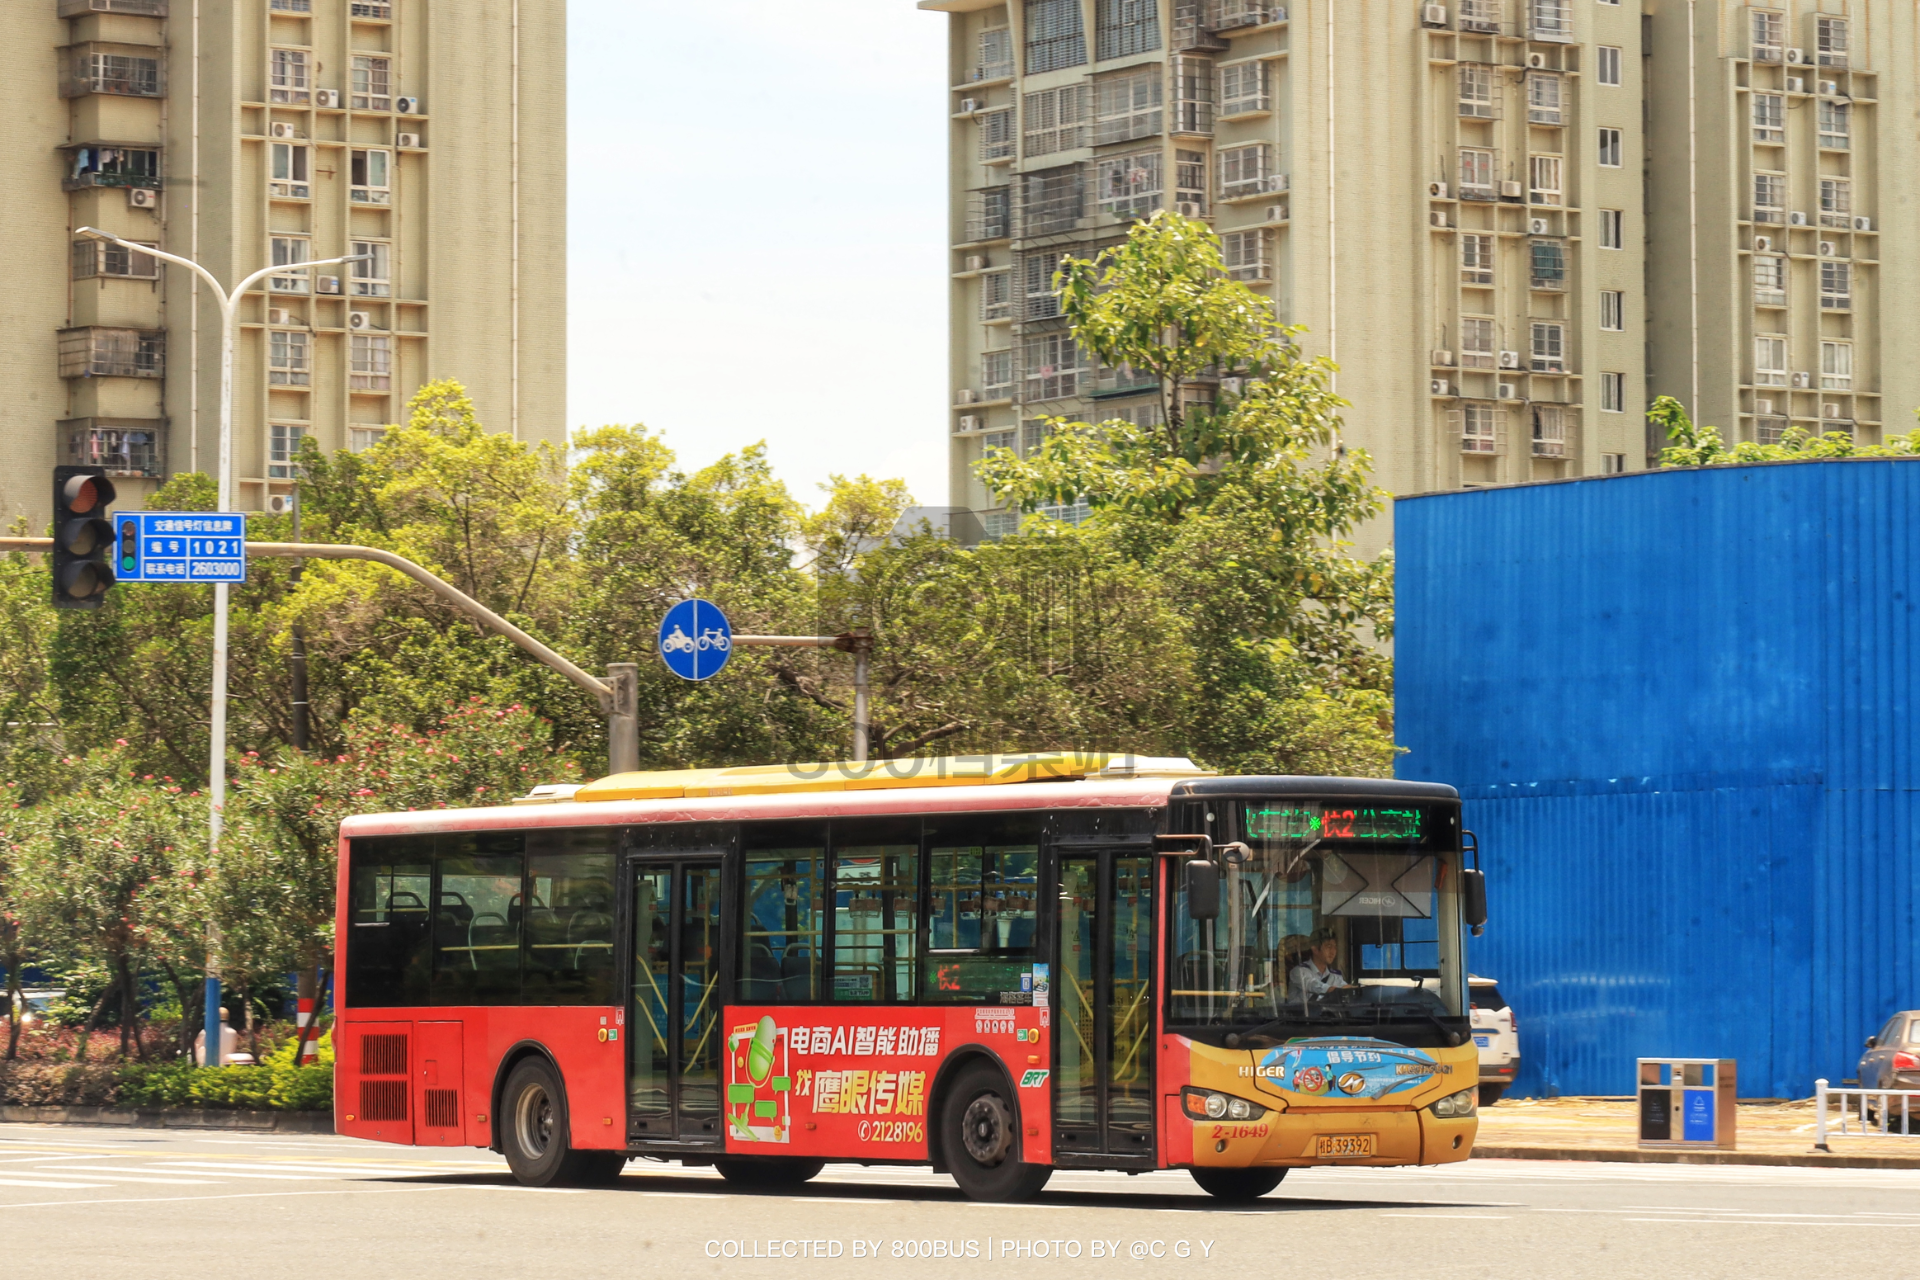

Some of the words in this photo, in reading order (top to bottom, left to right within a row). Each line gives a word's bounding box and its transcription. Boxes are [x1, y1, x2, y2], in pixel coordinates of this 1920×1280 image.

[154, 520, 233, 532] 交通信号灯信息牌
[193, 540, 239, 555] 1021
[145, 563, 185, 575] 联系电话
[191, 562, 240, 576] 2603000
[790, 1026, 940, 1056] 电商AI智能助播
[1326, 1050, 1382, 1063] 倡导节约
[1020, 1070, 1050, 1087] BRT
[1239, 1066, 1285, 1078] HIGER
[871, 1121, 924, 1143] 2128196
[1211, 1123, 1269, 1139] 2-1649
